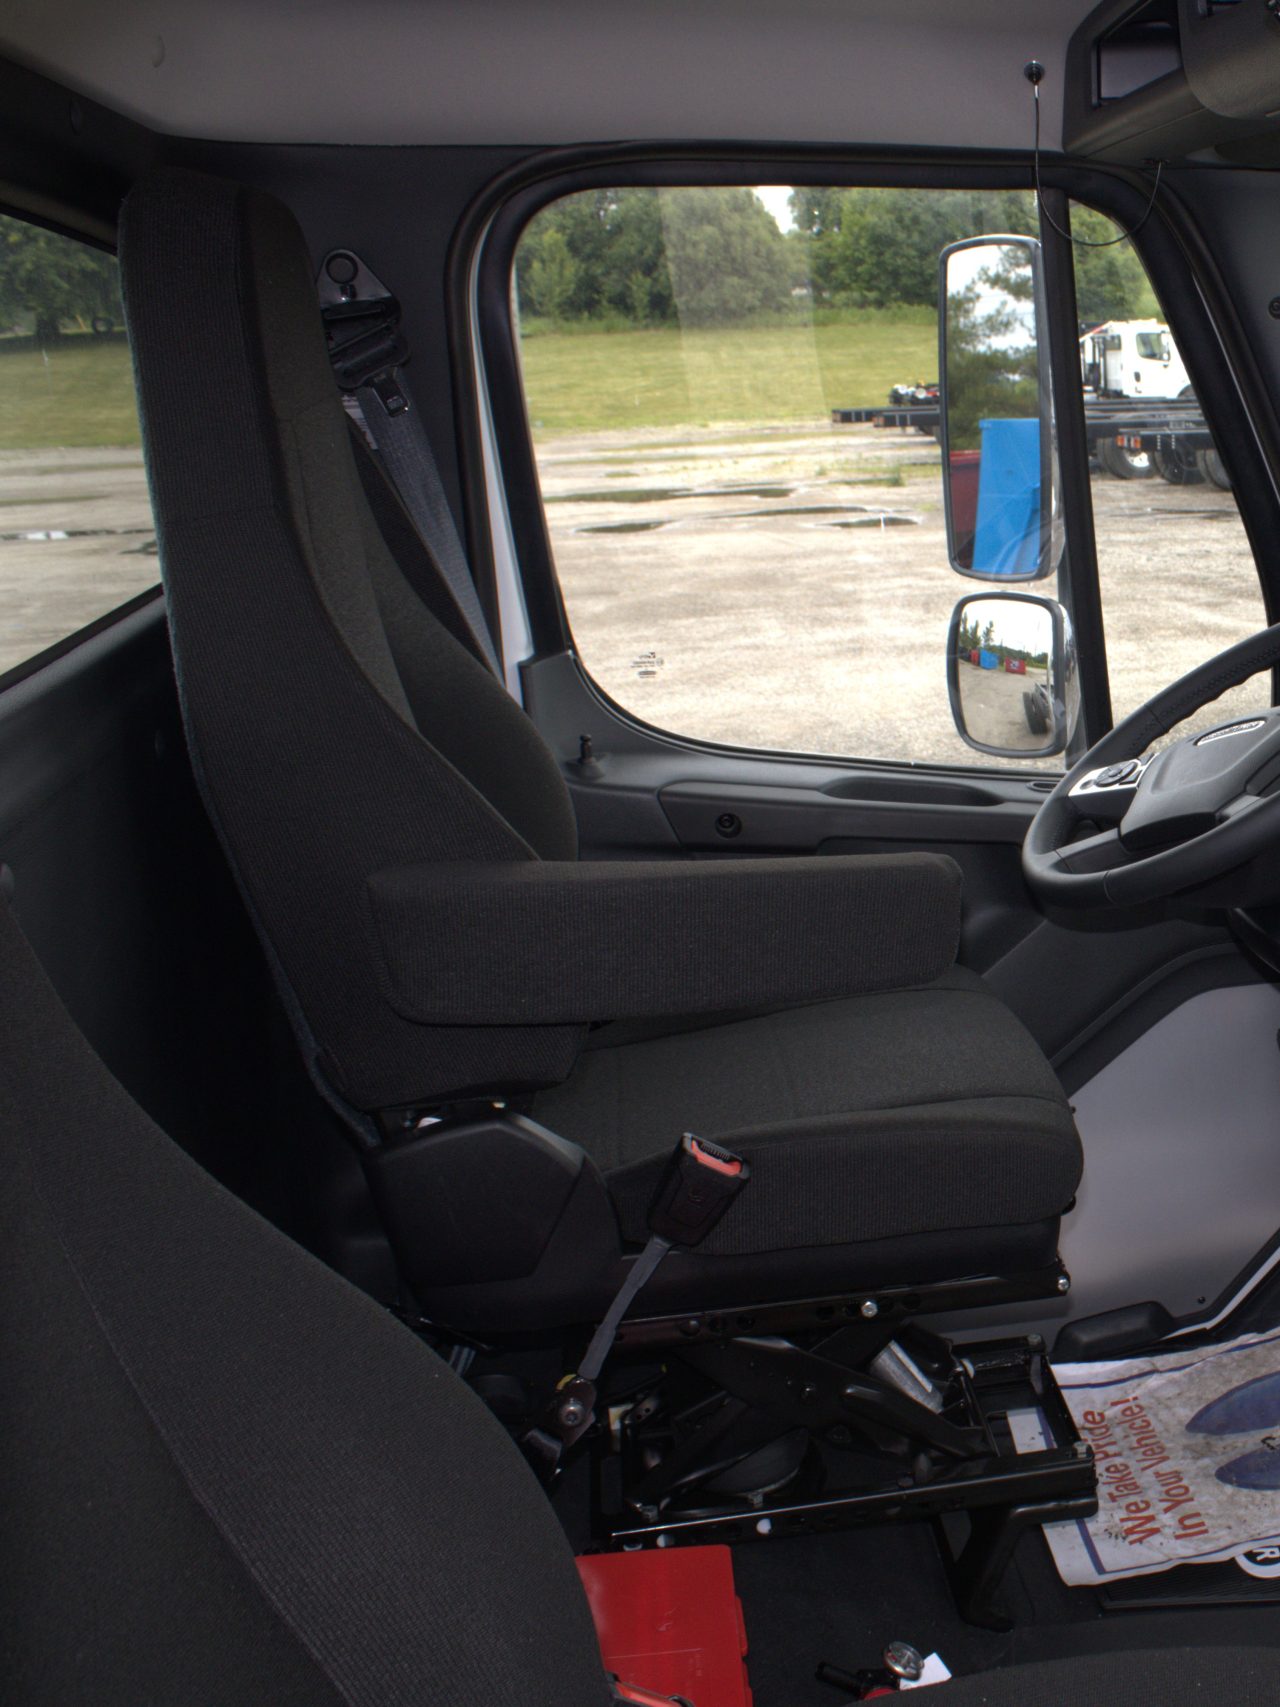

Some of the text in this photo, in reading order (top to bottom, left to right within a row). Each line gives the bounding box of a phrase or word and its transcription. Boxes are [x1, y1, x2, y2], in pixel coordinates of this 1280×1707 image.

[1079, 1410, 1161, 1545] We Take Pride
[1110, 1396, 1209, 1541] In Your Vehicle!
